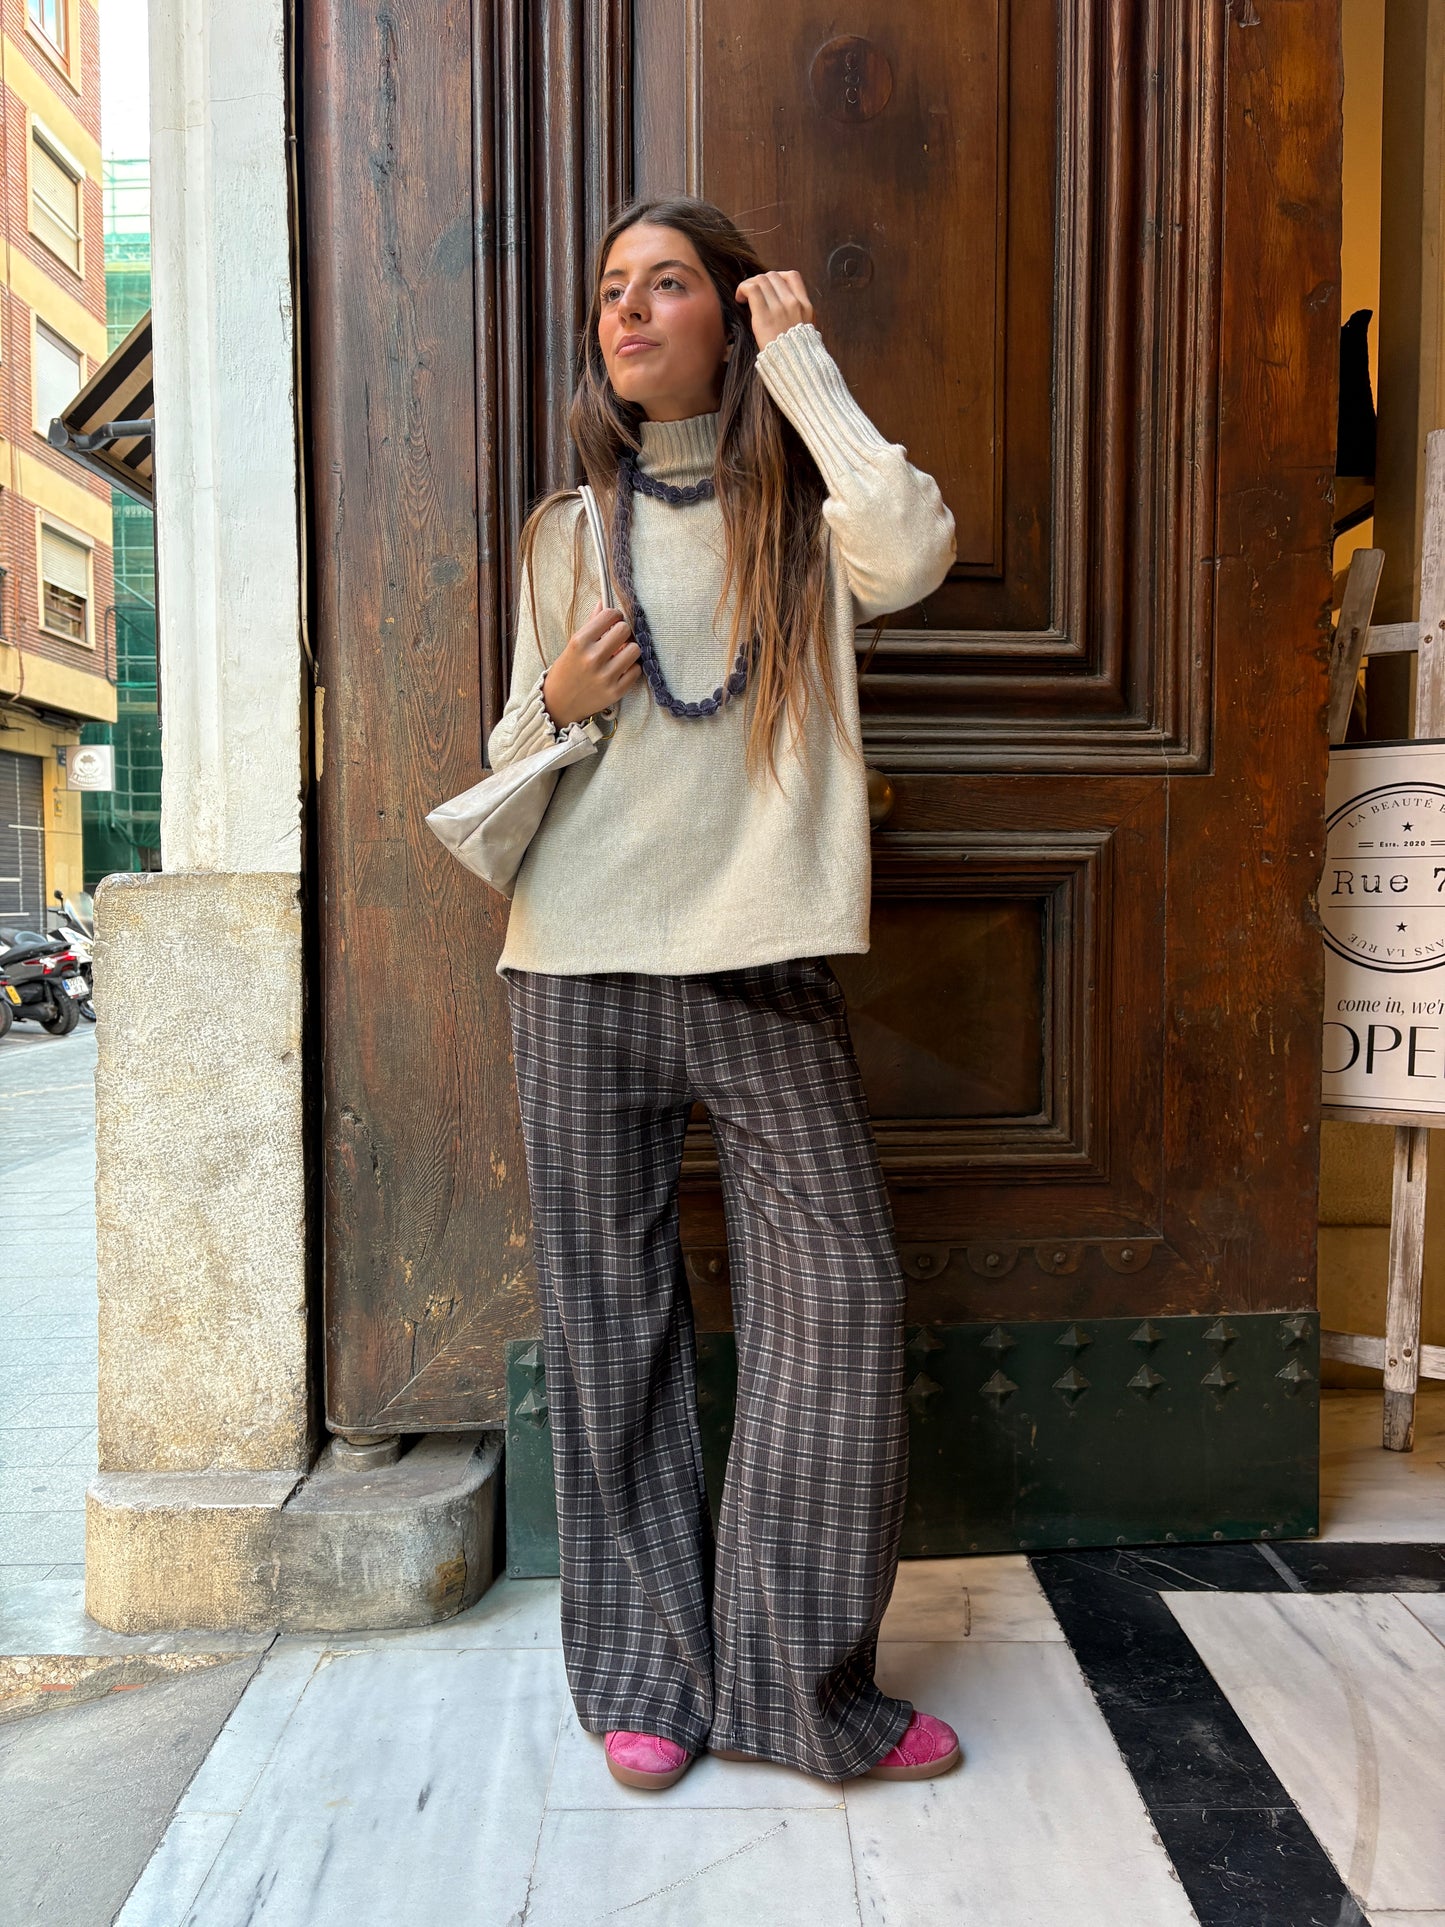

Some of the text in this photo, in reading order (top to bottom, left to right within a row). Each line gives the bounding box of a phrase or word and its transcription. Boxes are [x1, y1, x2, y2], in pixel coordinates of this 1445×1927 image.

[1347, 814, 1366, 829] LA
[1370, 798, 1433, 814] BEAUTÉ
[1331, 870, 1408, 895] Rue
[1348, 933, 1378, 953] RUE
[1386, 948, 1405, 957] LA
[1337, 999, 1381, 1013] come
[1385, 997, 1405, 1015] in,
[1322, 1022, 1445, 1079] OPE
